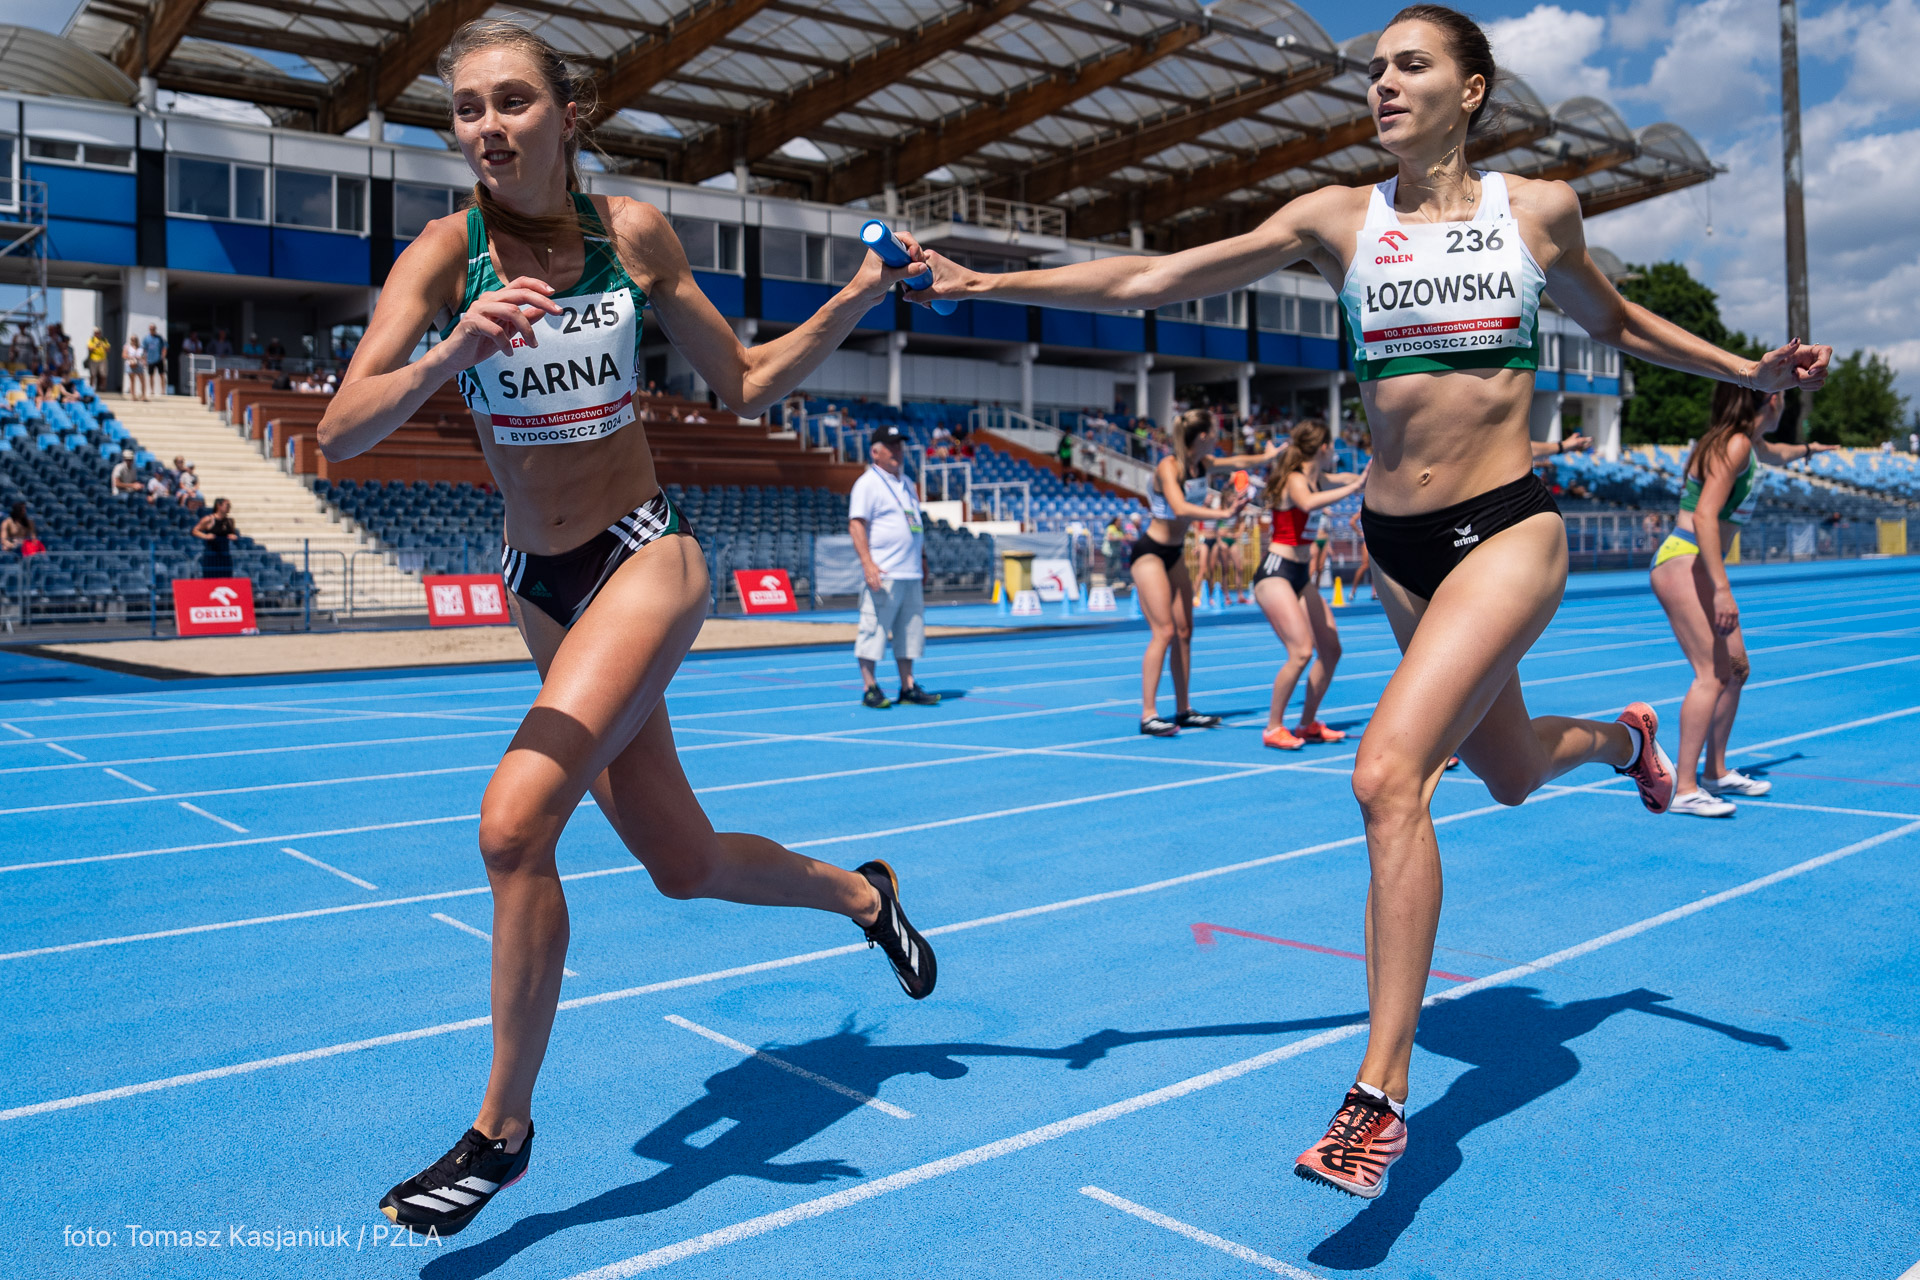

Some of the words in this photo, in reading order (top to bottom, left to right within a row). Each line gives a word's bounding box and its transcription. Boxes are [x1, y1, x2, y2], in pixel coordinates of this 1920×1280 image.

[1446, 228, 1504, 254] 236
[1375, 254, 1414, 265] ORLEN
[1366, 271, 1516, 313] ŁOZOWSKA
[560, 302, 620, 334] 245
[1384, 330, 1401, 339] 100.
[1402, 327, 1422, 336] PZLA
[1423, 321, 1475, 334] Mistrzostwa
[1477, 319, 1503, 328] Polski
[1385, 337, 1468, 354] BYDGOSZCZ
[1470, 334, 1503, 346] 2024
[498, 352, 622, 399] SARNA
[508, 416, 525, 426] 100.
[525, 418, 547, 426] PZLA
[548, 409, 603, 424] Mistrzostwa
[604, 401, 623, 414] Polski
[510, 425, 597, 442] BYDGOSZCZ
[600, 414, 622, 434] 2024
[1453, 535, 1478, 547] erima
[194, 609, 238, 619] ORLEN
